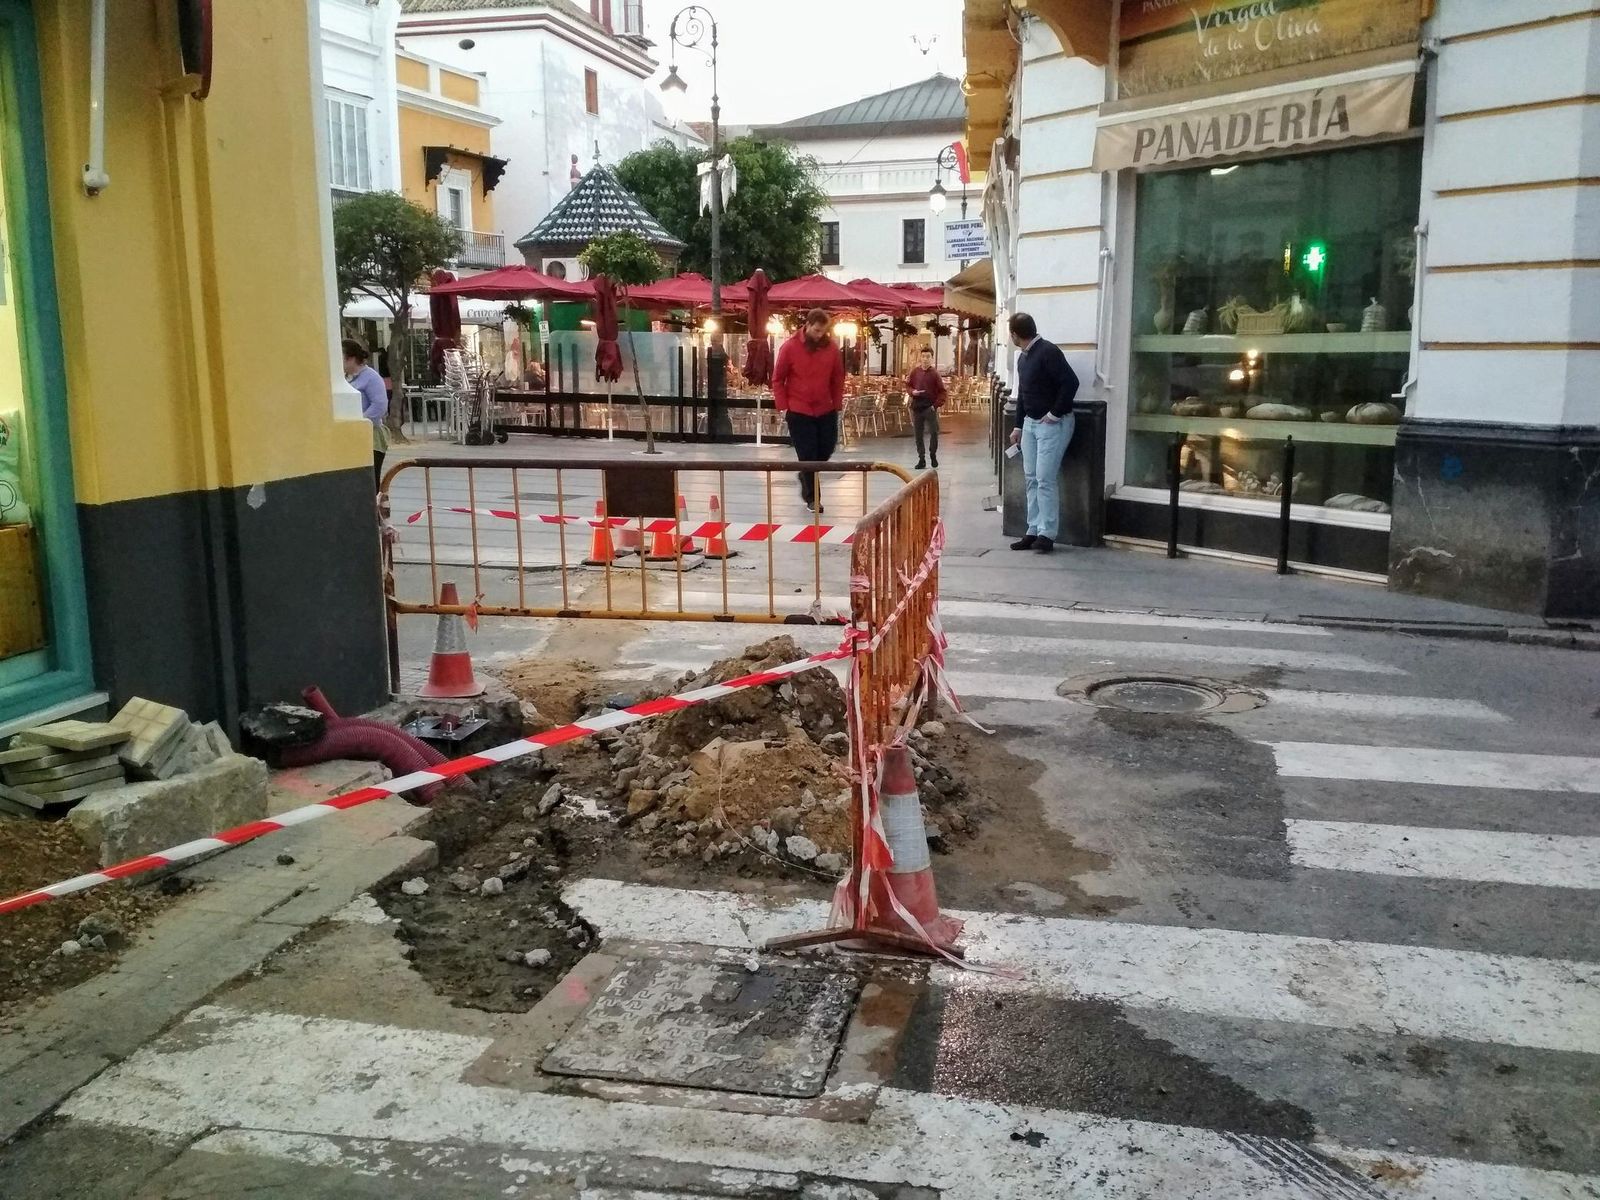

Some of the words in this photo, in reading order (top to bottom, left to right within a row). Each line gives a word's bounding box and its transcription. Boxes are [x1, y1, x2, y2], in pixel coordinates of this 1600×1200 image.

[1190, 0, 1278, 44] Virgen
[1203, 39, 1220, 58] de
[1228, 34, 1243, 52] la
[1255, 12, 1321, 51] Oliva
[1133, 88, 1350, 163] PANADERÍA
